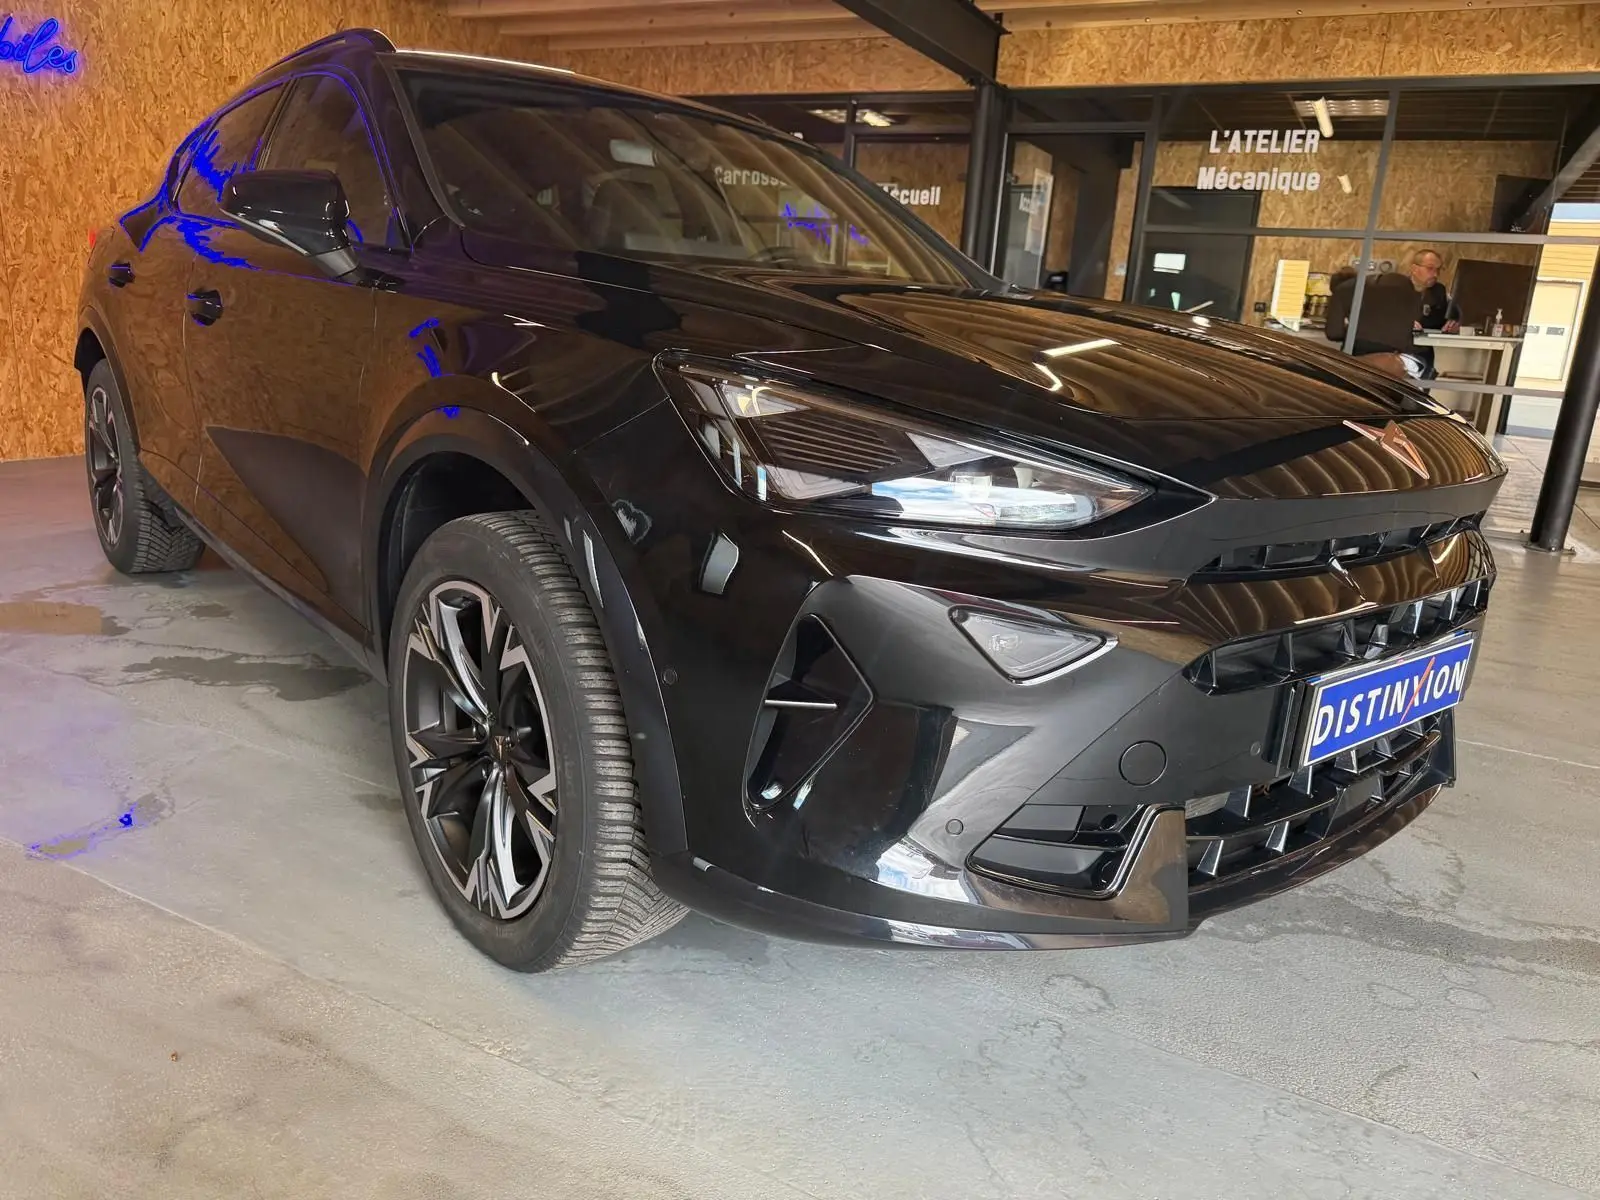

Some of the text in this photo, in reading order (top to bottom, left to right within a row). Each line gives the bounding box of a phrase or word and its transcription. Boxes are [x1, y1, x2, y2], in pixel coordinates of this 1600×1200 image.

[1209, 129, 1320, 154] L'ATELIER
[714, 166, 788, 186] Carross
[1197, 166, 1321, 195] Mécanique
[1312, 656, 1468, 747] DISTINXION
